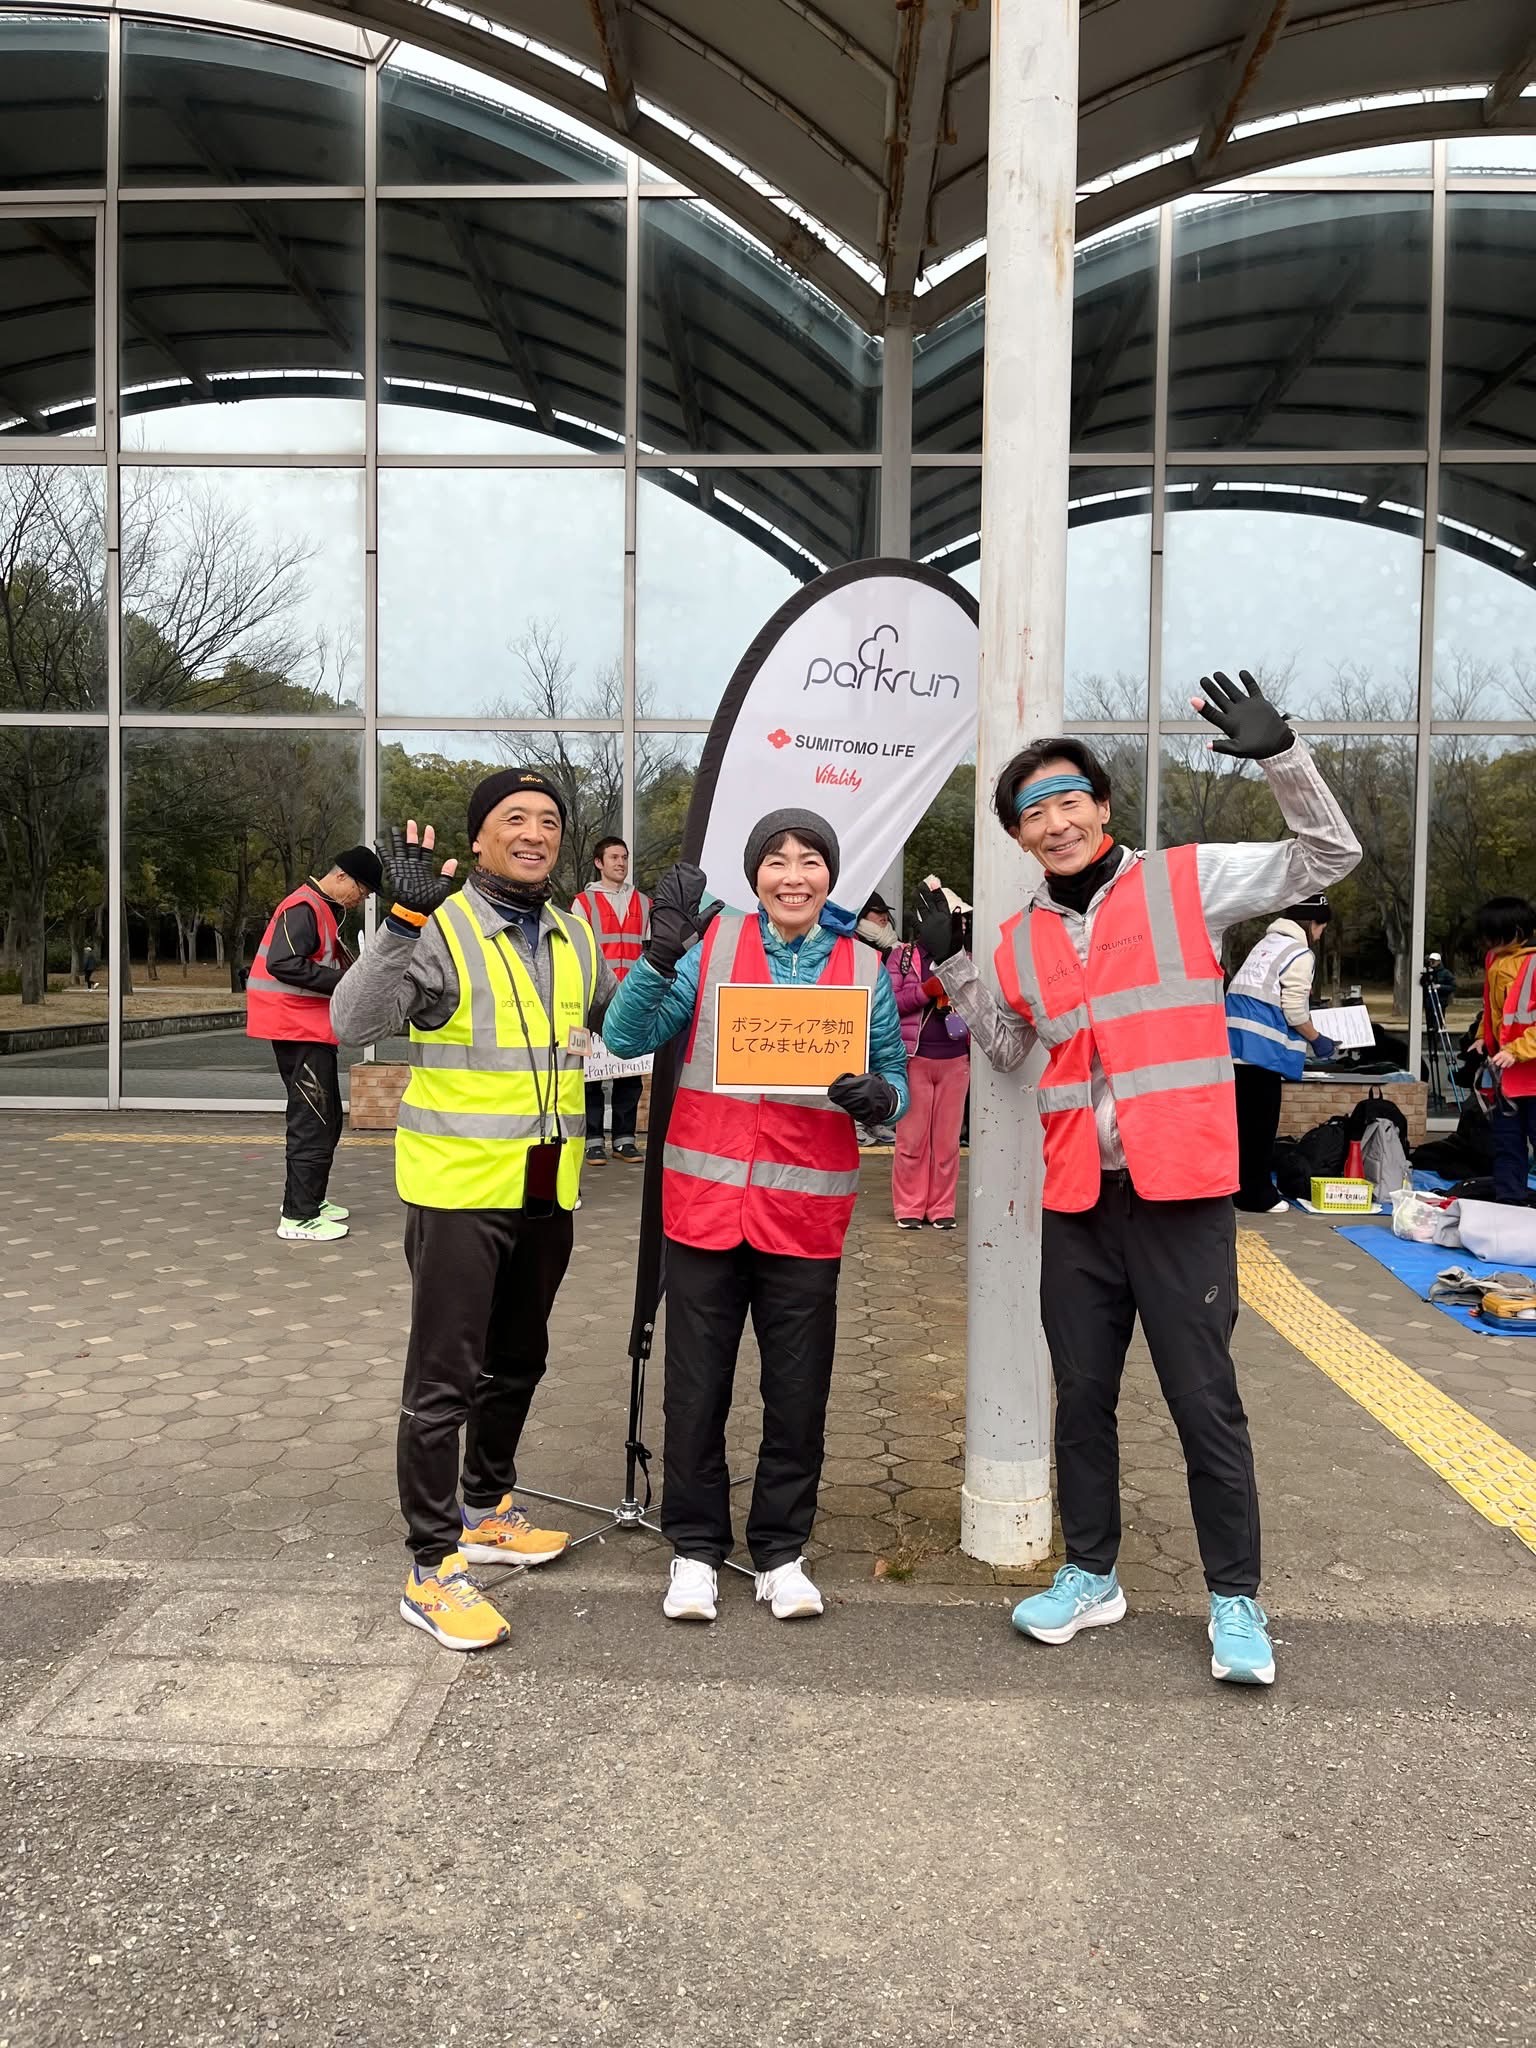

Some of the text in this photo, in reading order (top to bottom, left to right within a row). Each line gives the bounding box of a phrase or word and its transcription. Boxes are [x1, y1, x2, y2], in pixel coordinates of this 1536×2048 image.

[802, 624, 960, 699] parkrun
[795, 734, 916, 758] SUMITOMO LIFE
[815, 763, 863, 792] Vitality
[1096, 935, 1144, 952] VOLUNTEER
[501, 991, 535, 1008] parrun
[731, 1017, 854, 1035] ボランティア参加
[571, 1034, 586, 1049] Jun
[588, 1060, 651, 1078] Participants
